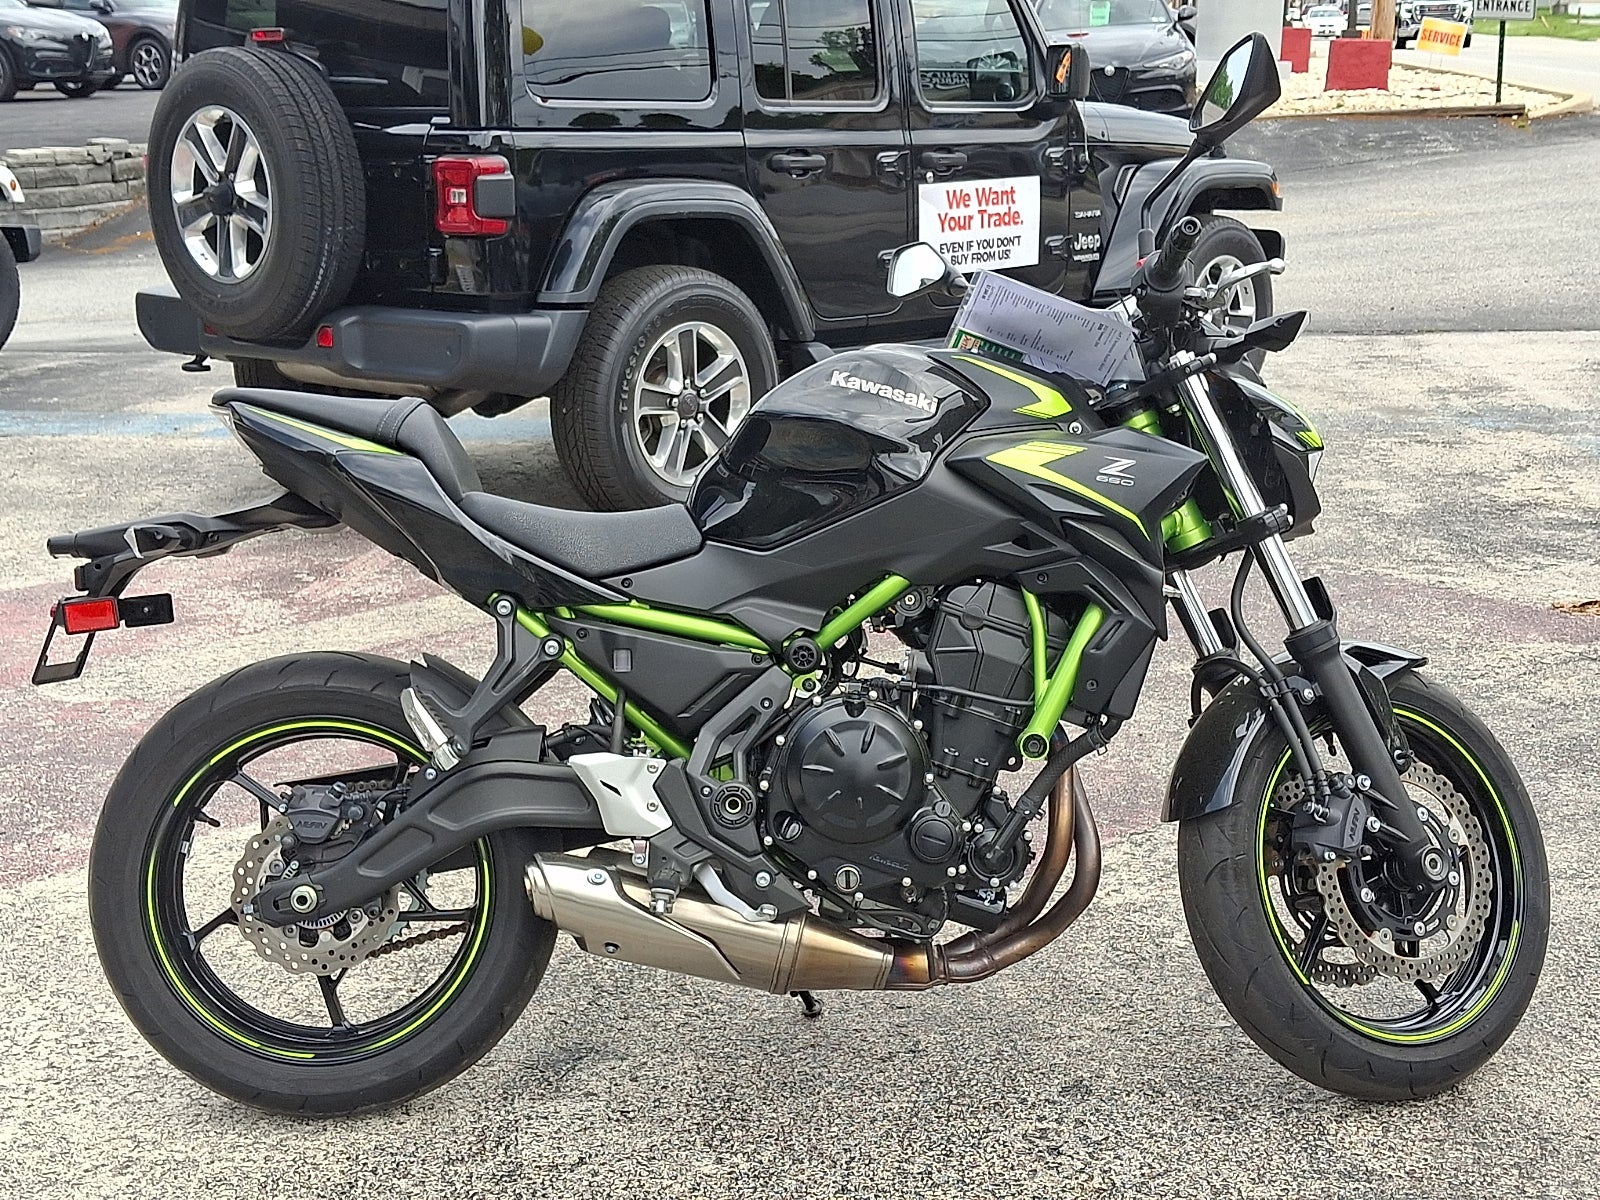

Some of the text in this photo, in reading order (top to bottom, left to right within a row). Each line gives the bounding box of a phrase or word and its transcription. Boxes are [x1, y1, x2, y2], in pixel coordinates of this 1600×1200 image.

[1476, 0, 1531, 12] ENTRANCE
[1421, 28, 1462, 46] SERVICE
[946, 186, 1016, 210] We Want
[938, 206, 1024, 233] Your Trade.
[940, 236, 1021, 254] EVEN IF YOU DON'T
[1073, 233, 1101, 251] Jeep
[951, 249, 1011, 265] BUY FROM US!
[830, 370, 939, 414] Kawasaki
[1098, 455, 1137, 479] Z
